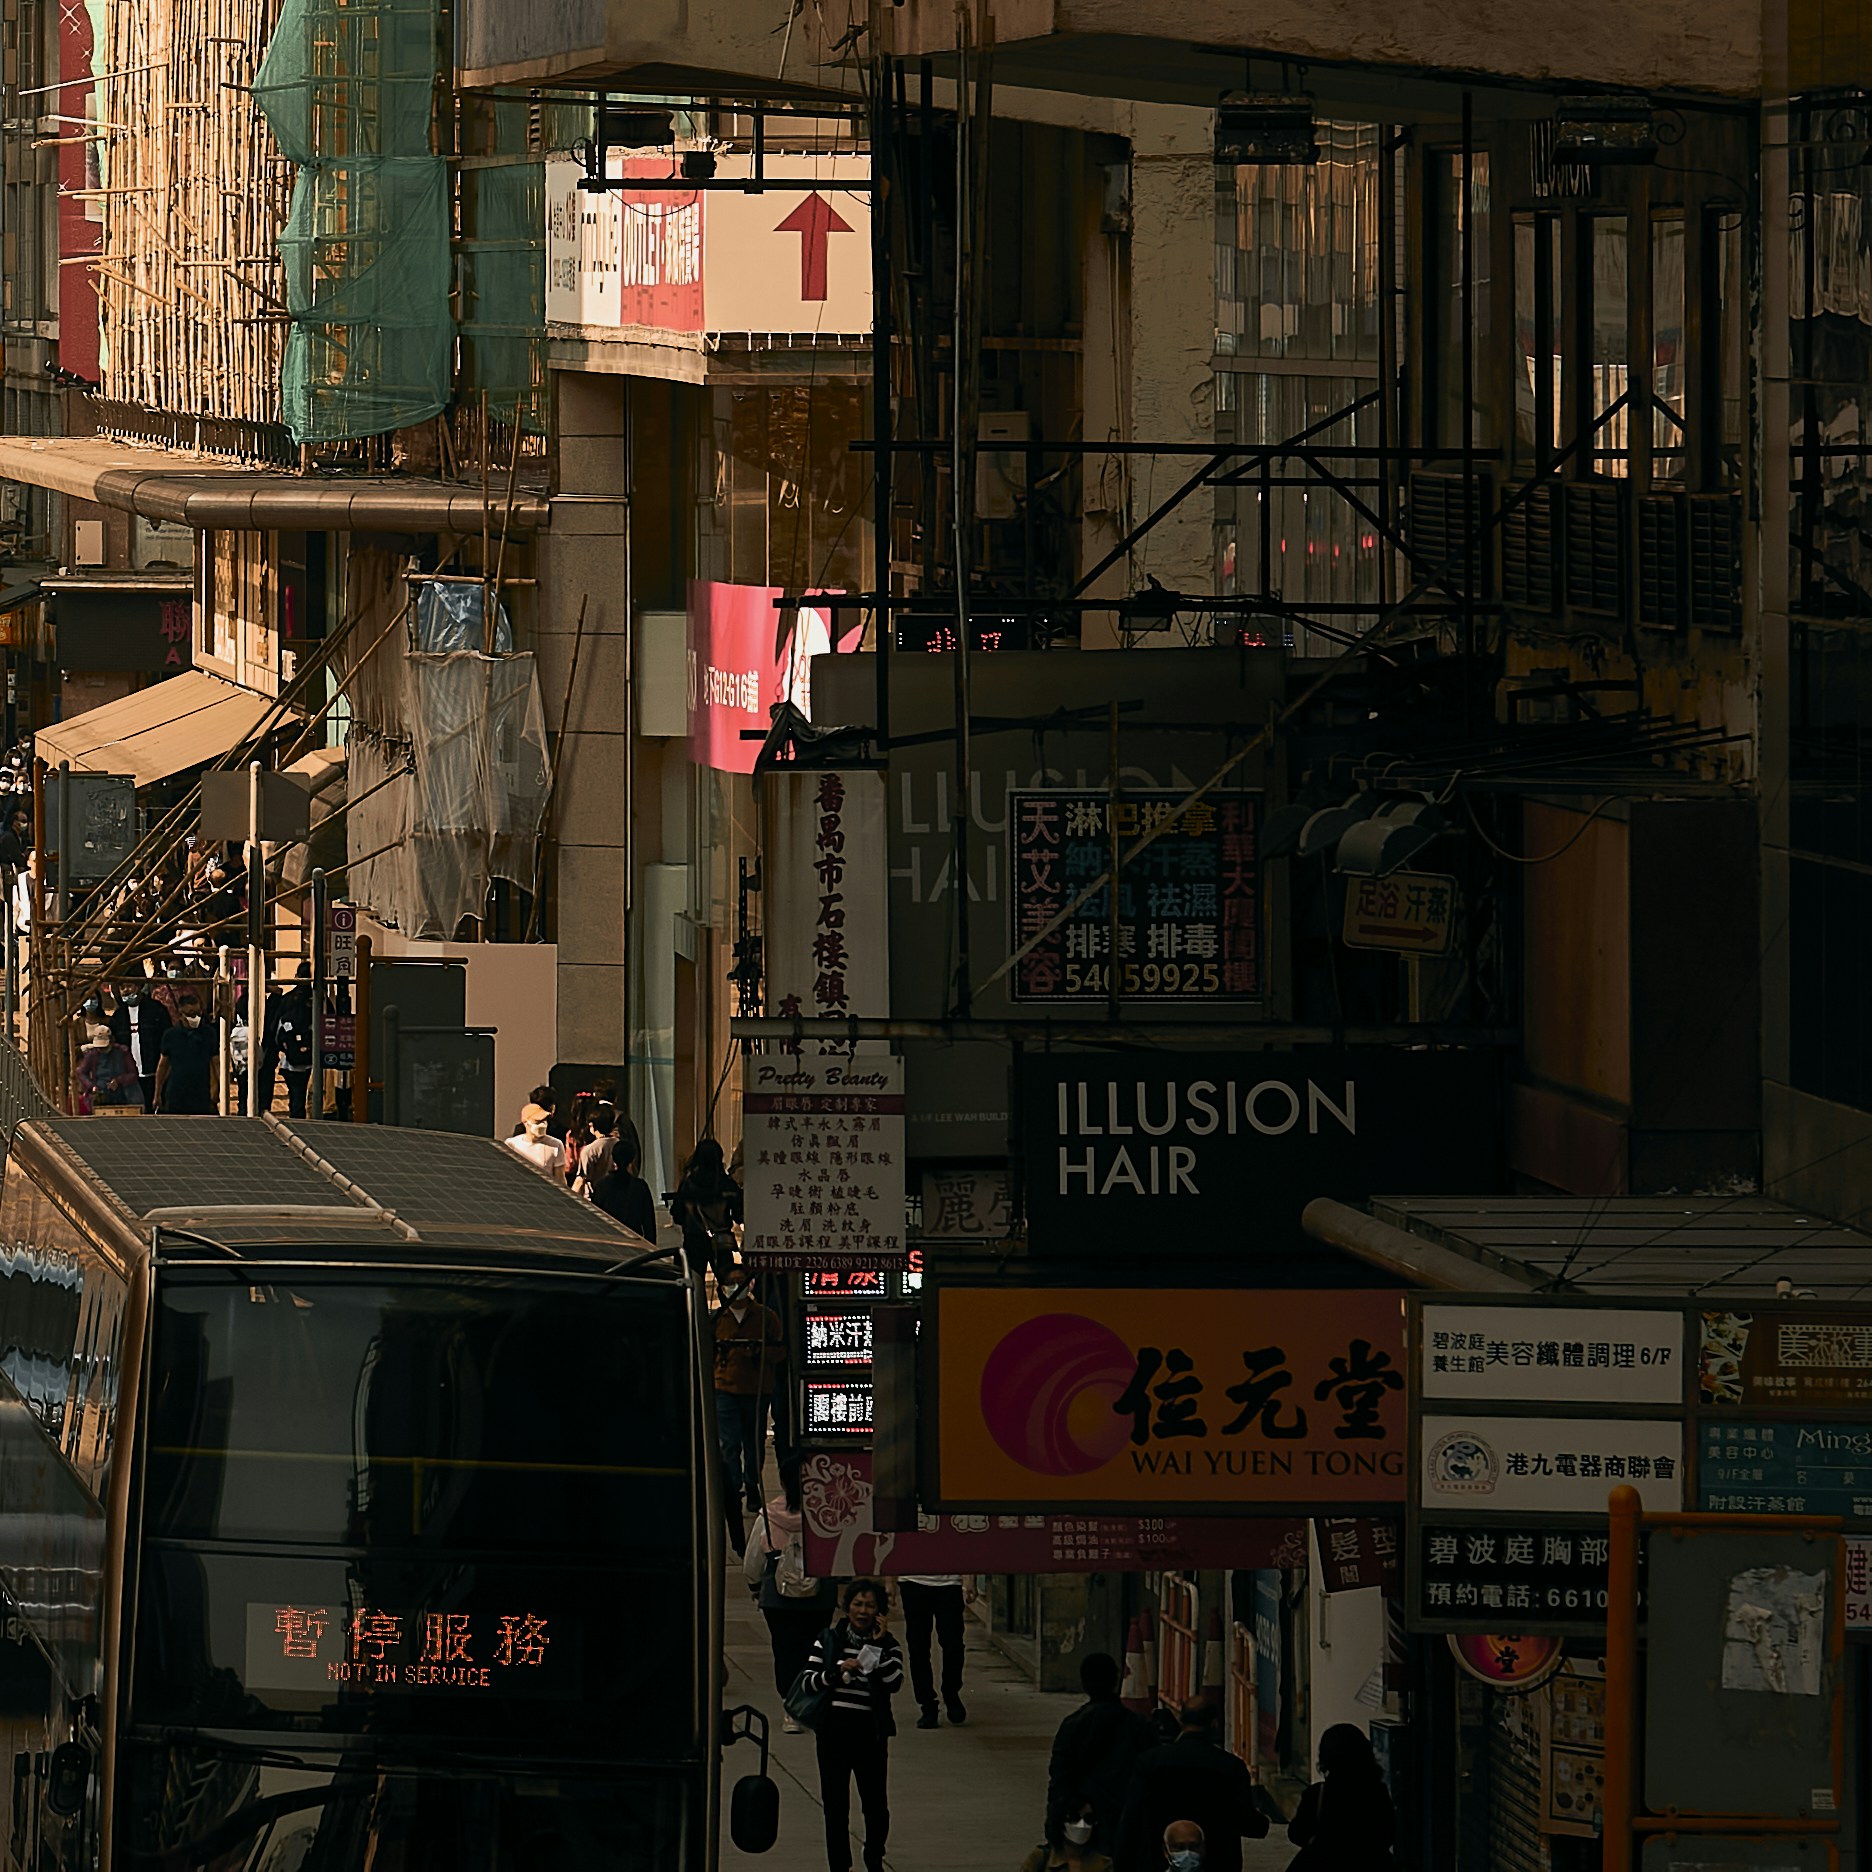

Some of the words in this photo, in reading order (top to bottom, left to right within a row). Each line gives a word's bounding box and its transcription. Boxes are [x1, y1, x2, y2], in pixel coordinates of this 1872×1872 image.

[1357, 880, 1400, 919] 足浴
[1404, 885, 1449, 924] 汗蒸
[335, 934, 352, 974] 旺角
[1147, 922, 1219, 959] 排毒
[758, 1066, 816, 1089] Pretty
[825, 1067, 889, 1090] Beauty
[935, 1112, 953, 1122] LEE
[955, 1112, 978, 1122] WAH
[1057, 1079, 1357, 1136] ILLUSION
[798, 1169, 851, 1183] 水晶唇
[1059, 1145, 1201, 1195] HAIR
[838, 1235, 900, 1250] 美甲課程
[806, 1256, 829, 1269] 2326
[830, 1256, 854, 1269] 6389
[855, 1256, 878, 1269] 9212
[880, 1257, 903, 1270] 8613
[1432, 1332, 1486, 1352] 碧波庭
[1485, 1340, 1635, 1369] 美容纖體調理
[1640, 1347, 1671, 1366] 6/F
[1432, 1355, 1486, 1374] 養生館
[1114, 1339, 1406, 1446] 位元堂
[1130, 1450, 1192, 1476] WAI
[1207, 1450, 1295, 1476] YUEN
[1305, 1450, 1405, 1476] TONG
[1505, 1452, 1676, 1480] 港九電器商聯會
[273, 1605, 553, 1669] 暫停服務
[326, 1662, 367, 1683] NOT
[375, 1663, 399, 1684] IN
[404, 1663, 491, 1687] SERVICE
